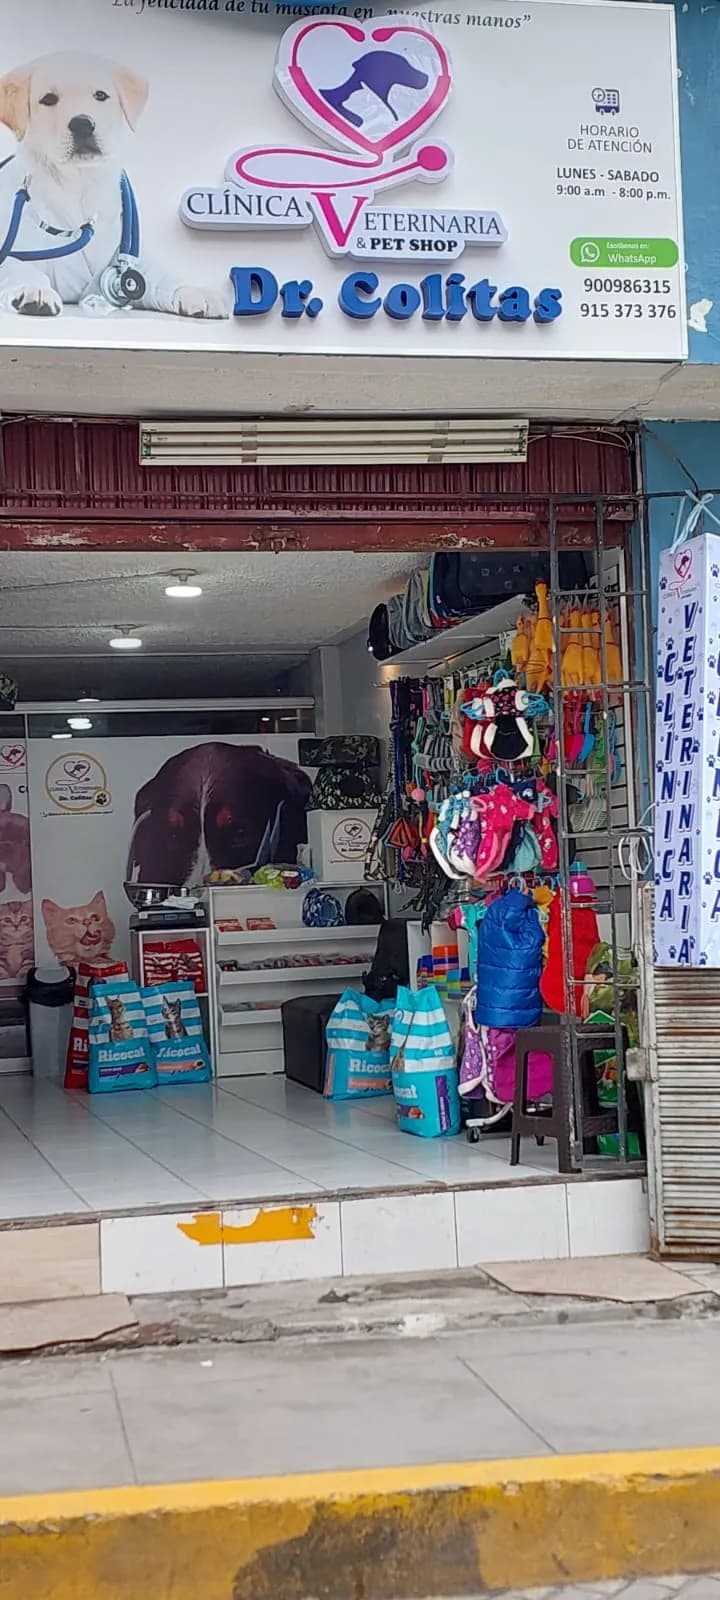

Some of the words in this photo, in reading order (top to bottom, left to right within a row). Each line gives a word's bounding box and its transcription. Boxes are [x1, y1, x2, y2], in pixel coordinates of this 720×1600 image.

[225, 0, 245, 12] de
[251, 0, 270, 14] tu
[354, 7, 373, 18] en
[580, 124, 640, 138] HORARIO
[567, 139, 585, 150] DE
[588, 139, 653, 153] ATENCIÓN
[556, 167, 597, 180] LUNES
[607, 169, 660, 183] SABADO
[556, 185, 582, 196] 9:00
[584, 188, 606, 197] a.m
[619, 187, 644, 199] 8:00
[646, 191, 671, 201] p.m.
[186, 189, 304, 218] CLÍNICA
[356, 236, 367, 249] &
[370, 237, 406, 251] PET
[409, 239, 459, 252] SHOP
[607, 253, 657, 265] WhatsApp
[583, 278, 671, 294] 900986315
[230, 266, 324, 319] Dr.
[338, 270, 563, 324] Colitas
[580, 303, 609, 318] 915
[614, 304, 643, 319] 373
[648, 305, 677, 319] 376
[660, 652, 676, 918] CLÍNICA
[677, 601, 697, 964] VETERINARIA
[98, 1046, 145, 1062] Ricocat
[348, 1058, 391, 1074] Ricoc
